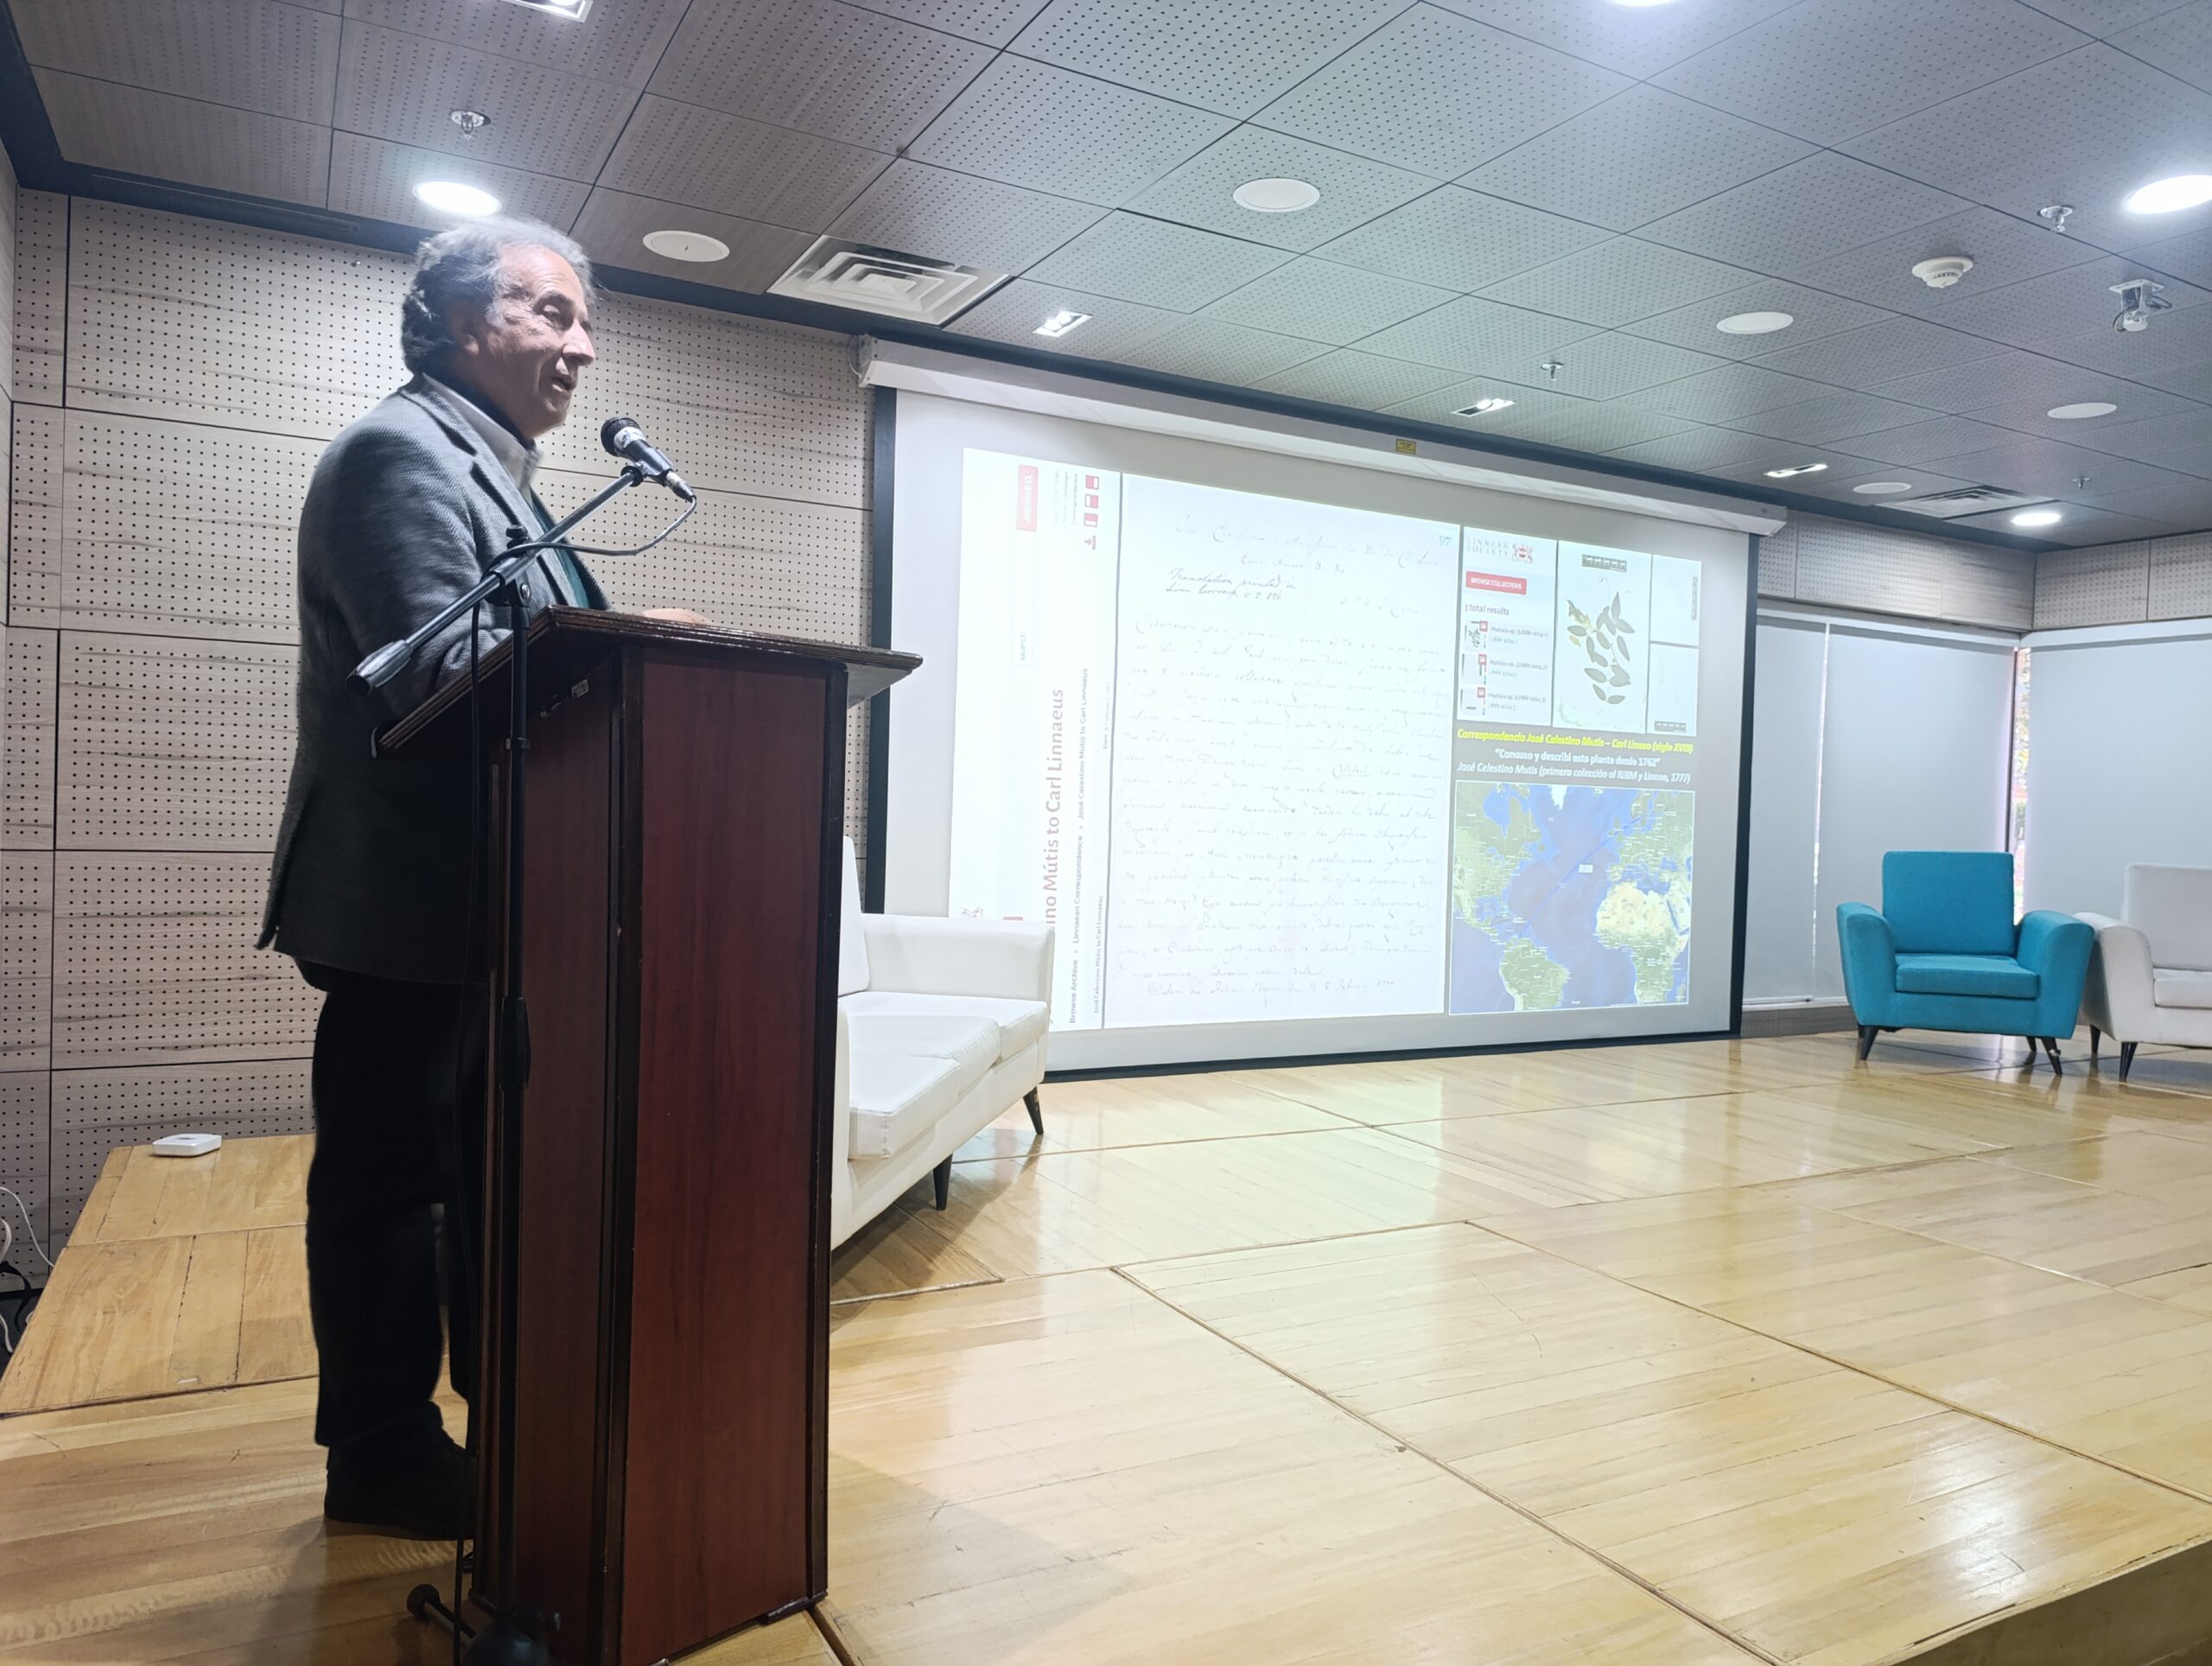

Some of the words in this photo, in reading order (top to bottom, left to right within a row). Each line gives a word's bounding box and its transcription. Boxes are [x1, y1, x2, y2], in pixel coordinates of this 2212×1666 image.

[1466, 545, 1508, 557] SOCIETY
[1470, 604, 1485, 613] total
[1487, 607, 1510, 615] results
[1046, 689, 1063, 771] Linnaeus
[1458, 728, 1526, 742] Correspondencia
[1526, 733, 1544, 743] José
[1545, 734, 1580, 746] Celestino
[1581, 736, 1605, 747] Mutis
[1611, 738, 1627, 749] Carl
[1628, 740, 1651, 750] Linneo
[1651, 741, 1673, 753] (siglo
[1458, 761, 1476, 772] José
[1477, 762, 1514, 773] Celestino
[1514, 764, 1538, 774] Mutis
[1539, 766, 1572, 777] (primera
[1573, 768, 1607, 778] colección
[1608, 769, 1617, 778] al
[1637, 773, 1643, 782] y
[1643, 772, 1669, 783] Linneo,
[1670, 773, 1691, 785] 1777)
[1534, 753, 1540, 762] y
[1573, 754, 1589, 763] esta
[1590, 754, 1615, 766] planta
[1615, 755, 1637, 766] desde
[1045, 777, 1061, 812] Carl
[1045, 817, 1059, 835] to
[1042, 839, 1058, 892] Mútis
[1073, 836, 1083, 904] Correspondence
[1071, 906, 1080, 944] Linnaean
[1070, 959, 1078, 991] Archive
